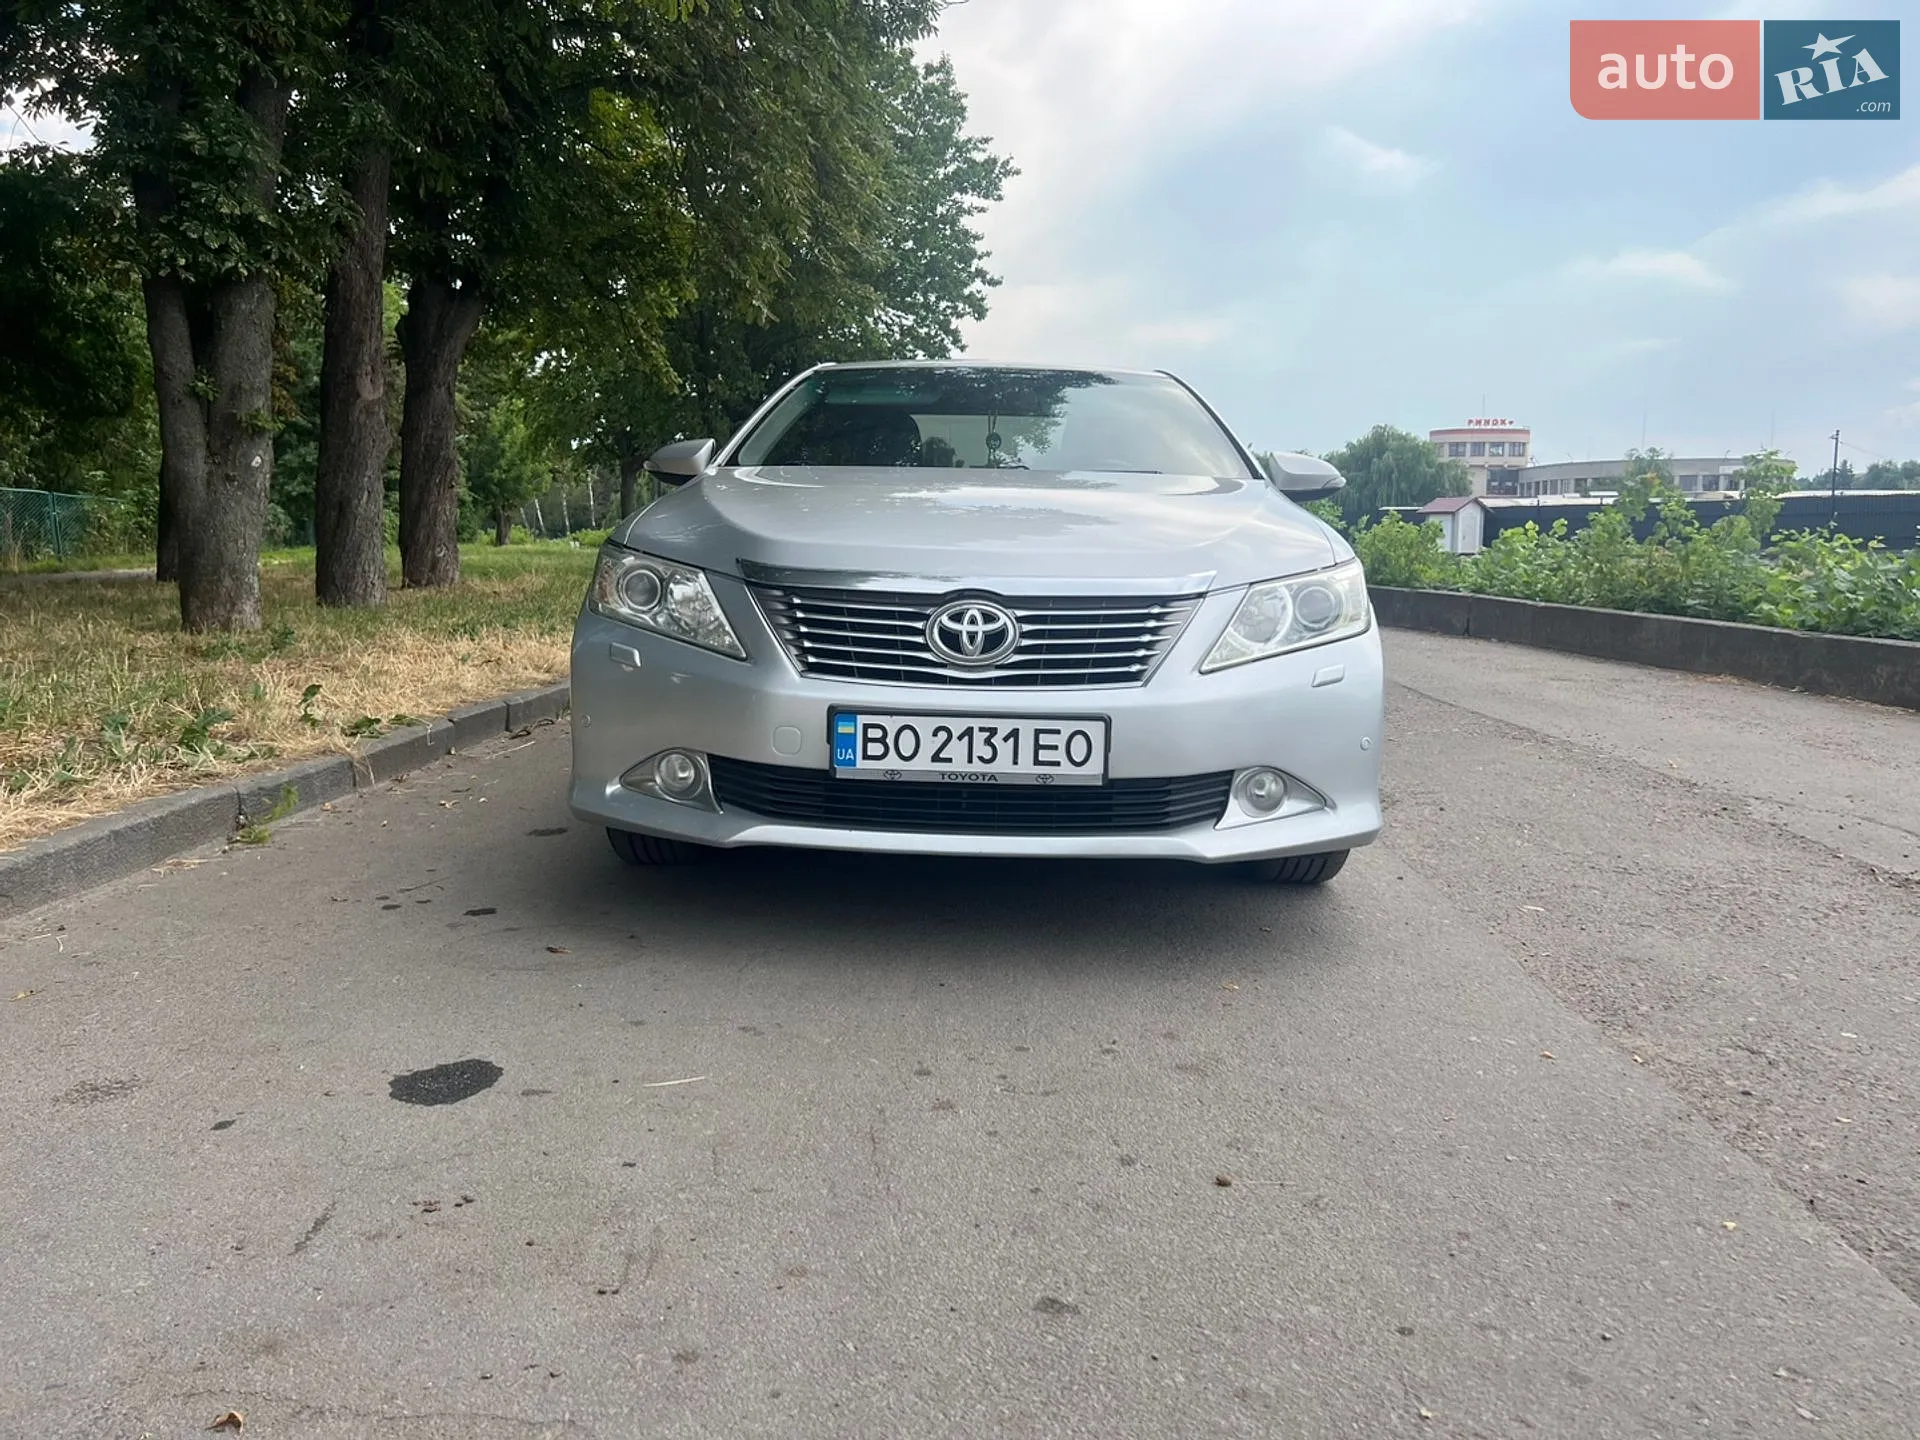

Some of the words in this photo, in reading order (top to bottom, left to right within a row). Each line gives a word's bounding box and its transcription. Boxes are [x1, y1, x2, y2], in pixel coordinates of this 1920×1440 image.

[836, 748, 855, 761] UA
[861, 722, 921, 762] BO
[930, 725, 1020, 766] 2131
[1032, 728, 1093, 768] EO
[938, 773, 998, 783] TOYOTA
